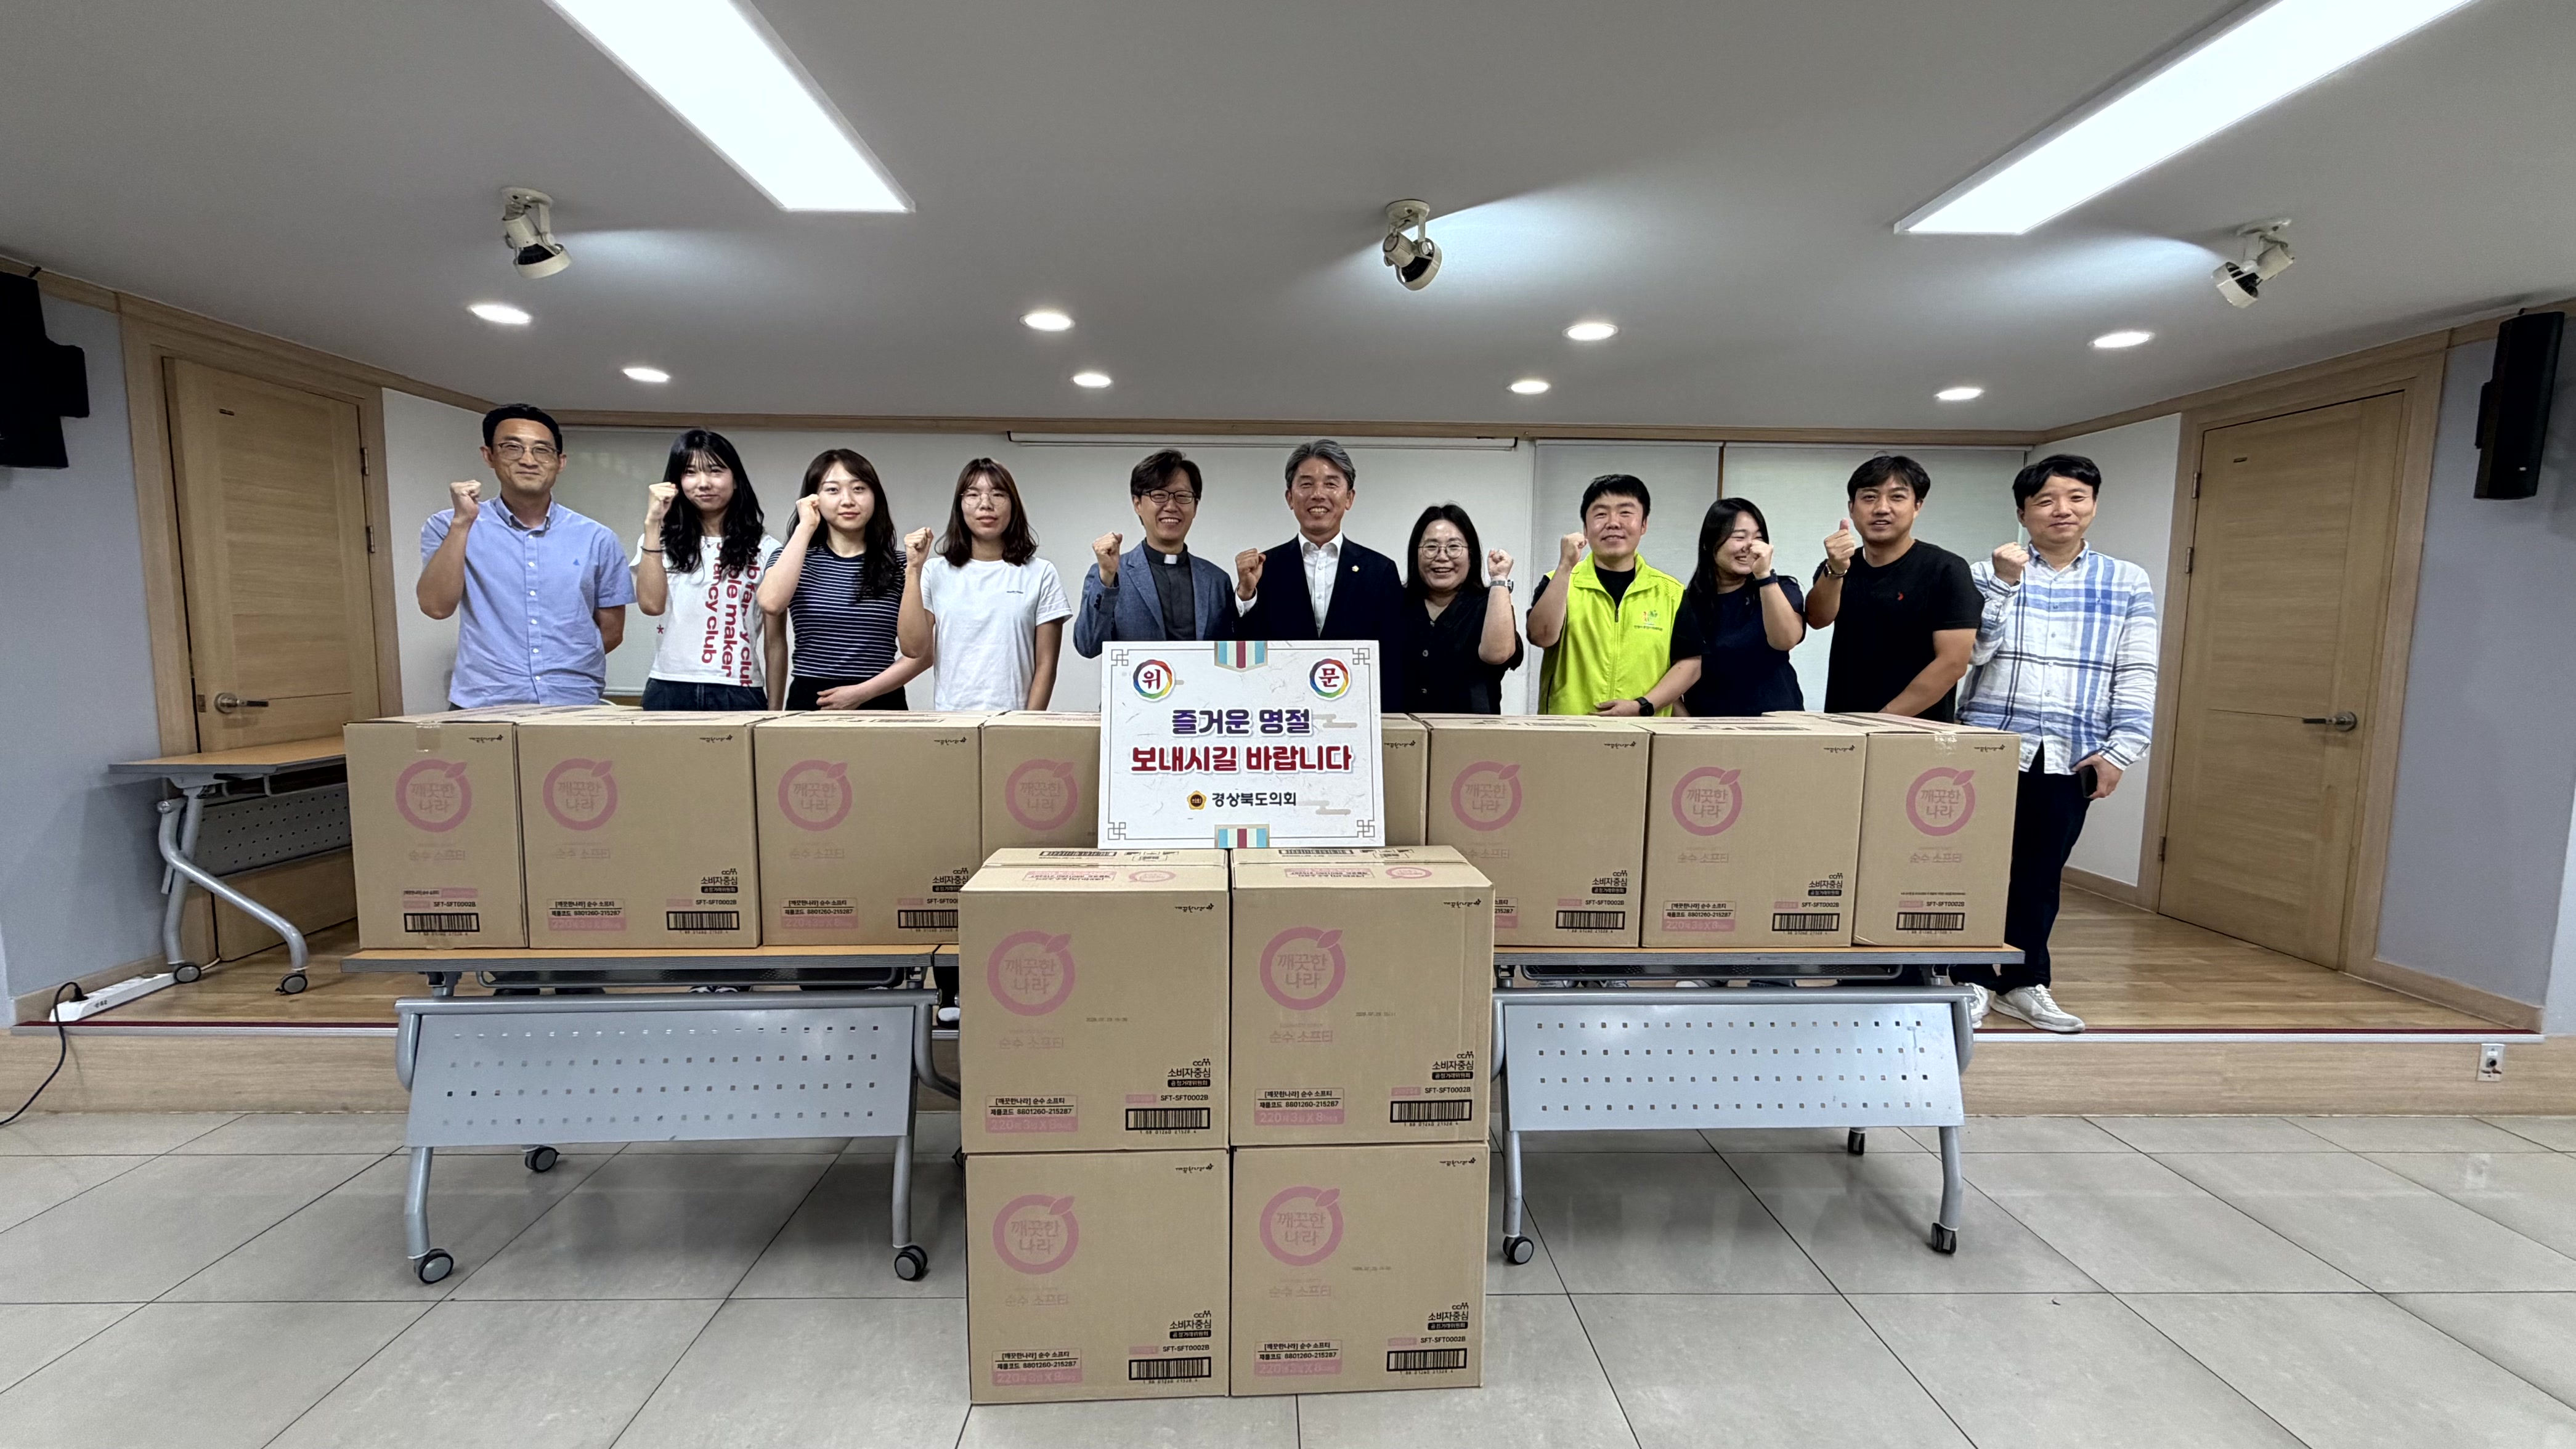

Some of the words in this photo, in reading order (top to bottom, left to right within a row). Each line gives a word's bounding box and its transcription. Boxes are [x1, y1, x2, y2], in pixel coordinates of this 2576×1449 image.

[739, 583, 755, 644] fany
[701, 616, 718, 664] club
[721, 604, 737, 678] maker
[1142, 668, 1161, 690] 위
[1318, 668, 1340, 688] 문
[1172, 709, 1249, 734] 즐거운
[1259, 708, 1311, 734] 명절
[1132, 746, 1237, 771] 보내시길
[1246, 745, 1353, 771] 바랍니다
[1465, 784, 1506, 798] 깨끗한
[1687, 789, 1728, 804] 깨끗한
[1921, 789, 1960, 804] 깨끗한
[1212, 792, 1296, 807] 경상북도의회
[1473, 800, 1500, 813] 나라
[1693, 805, 1721, 818] 나라
[1926, 805, 1954, 818] 나라
[701, 876, 737, 885] 소비자중심
[932, 875, 969, 884] 소비자중심
[1592, 878, 1627, 886] 소비자중심
[1809, 880, 1842, 888] 소비자중심
[1005, 959, 1055, 976] 깨끗한
[1278, 954, 1328, 971] 깨끗한
[1014, 978, 1050, 994] 나라
[1285, 973, 1320, 989] 나라
[1432, 1060, 1474, 1070] 소비자중심
[1168, 1068, 1211, 1078] 소비자중심
[1277, 1212, 1326, 1228] 깨끗한
[1010, 1220, 1059, 1237] 깨끗한
[1285, 1230, 1319, 1246] 나라
[1019, 1239, 1054, 1254] 나라
[1428, 1311, 1469, 1321] 소비자중심
[1169, 1319, 1211, 1329] 소비자중심
